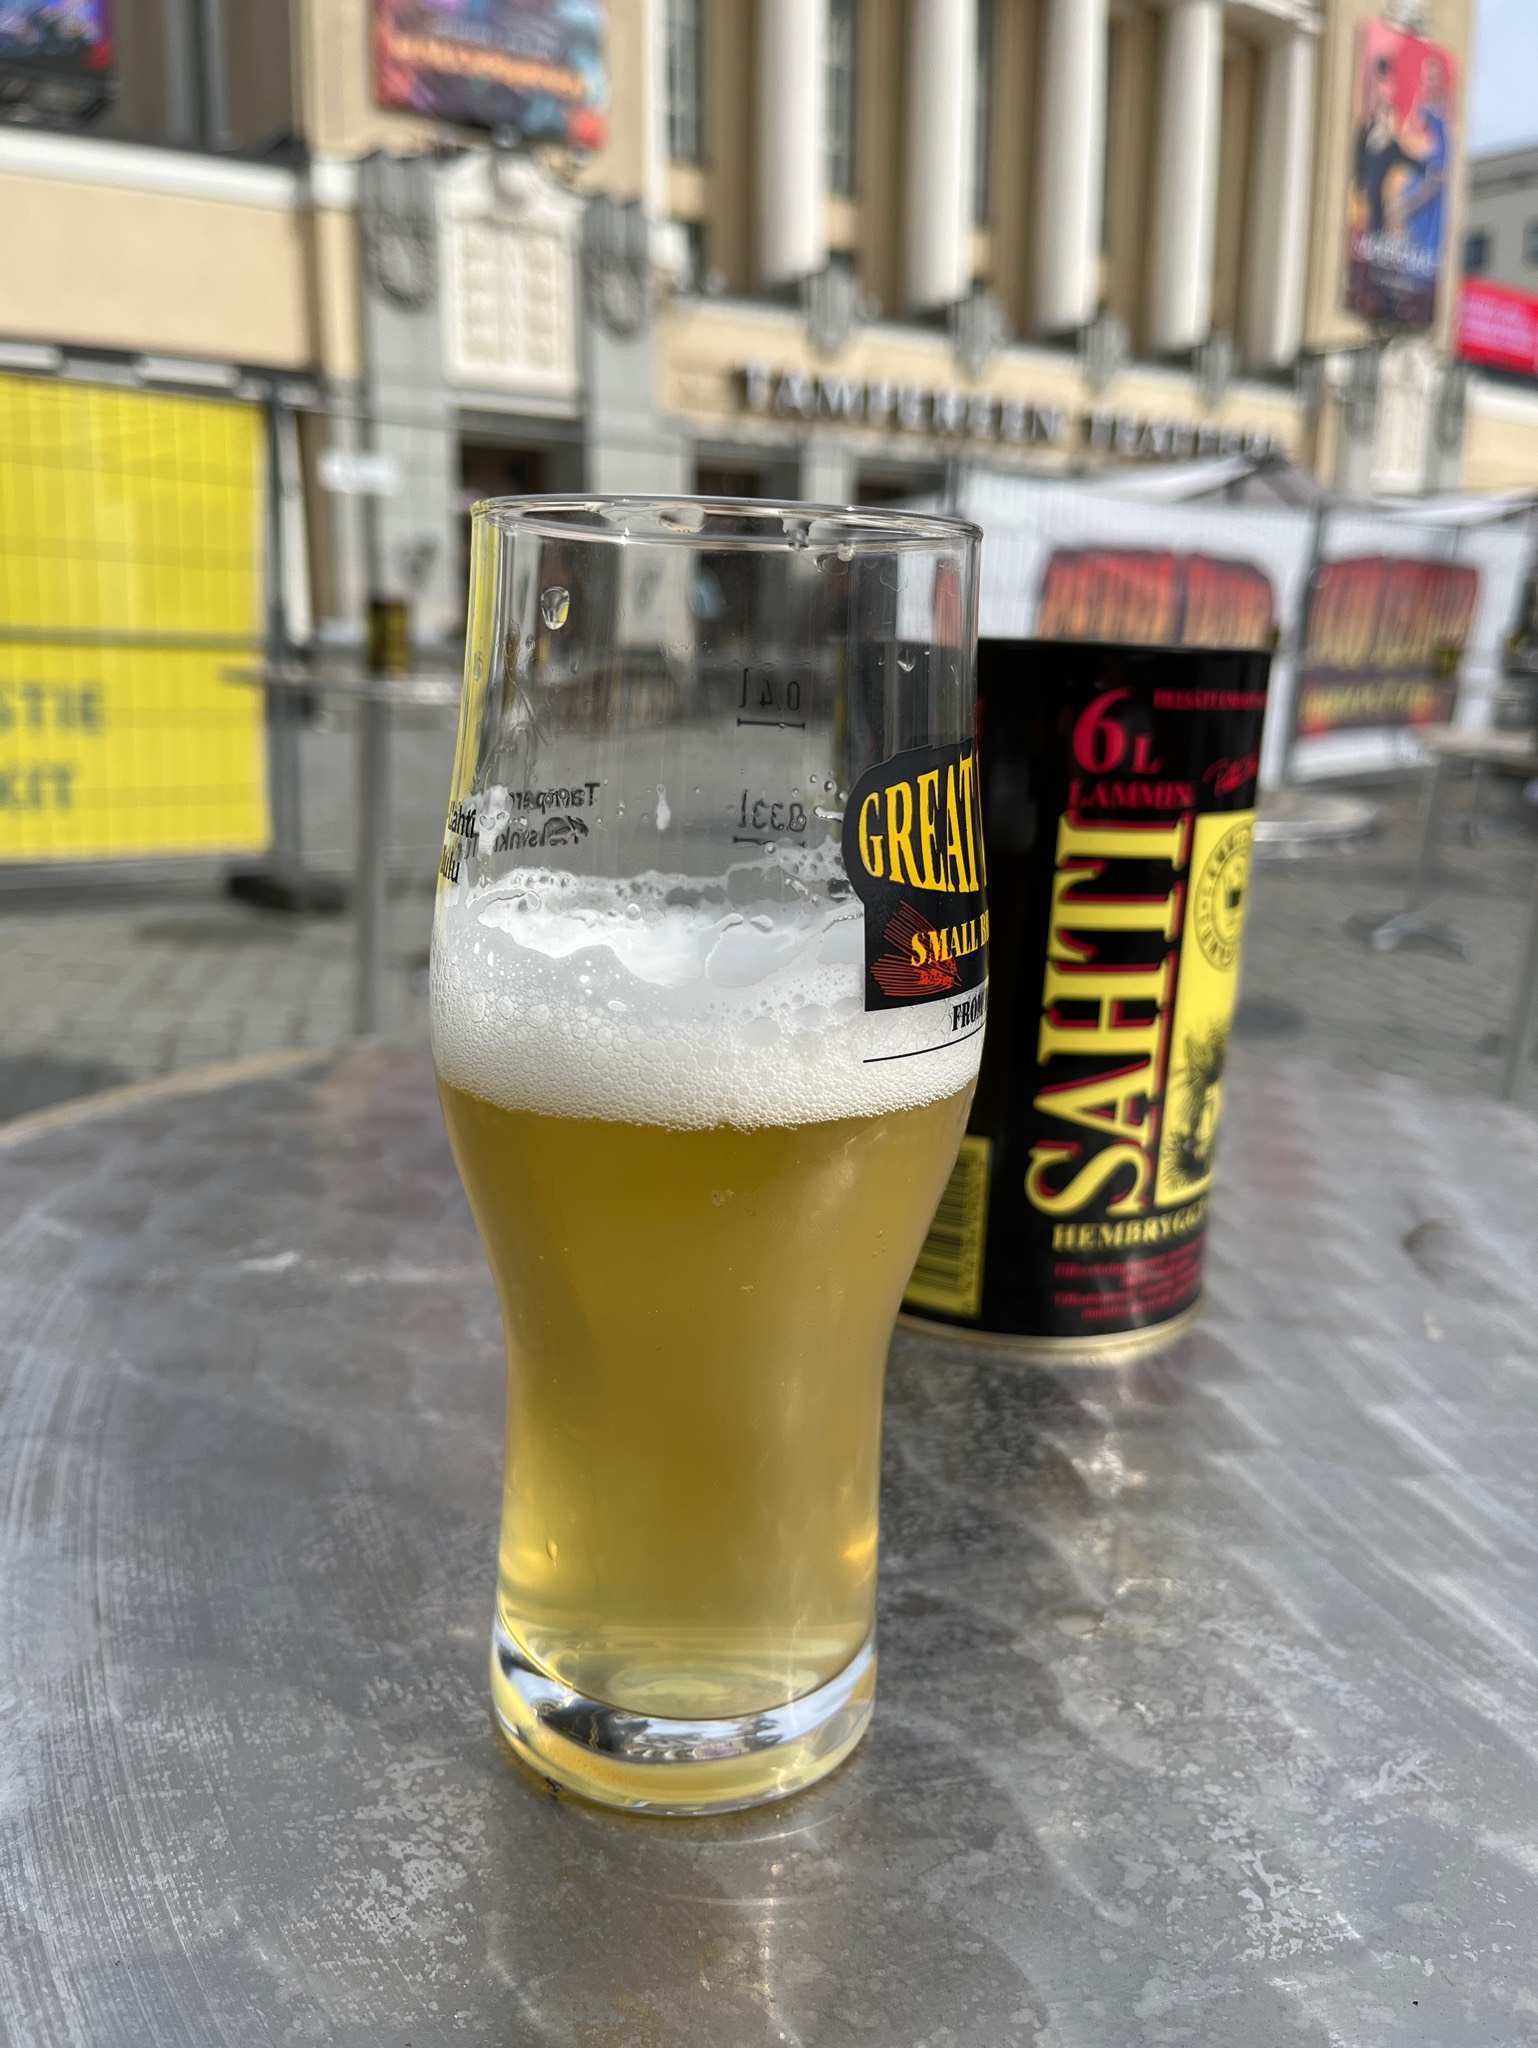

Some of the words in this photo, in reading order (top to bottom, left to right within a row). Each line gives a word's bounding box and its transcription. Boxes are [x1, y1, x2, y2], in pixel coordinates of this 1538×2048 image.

[859, 748, 979, 893] GREAT
[911, 919, 978, 967] SMALL
[1023, 810, 1196, 1217] SAHTI
